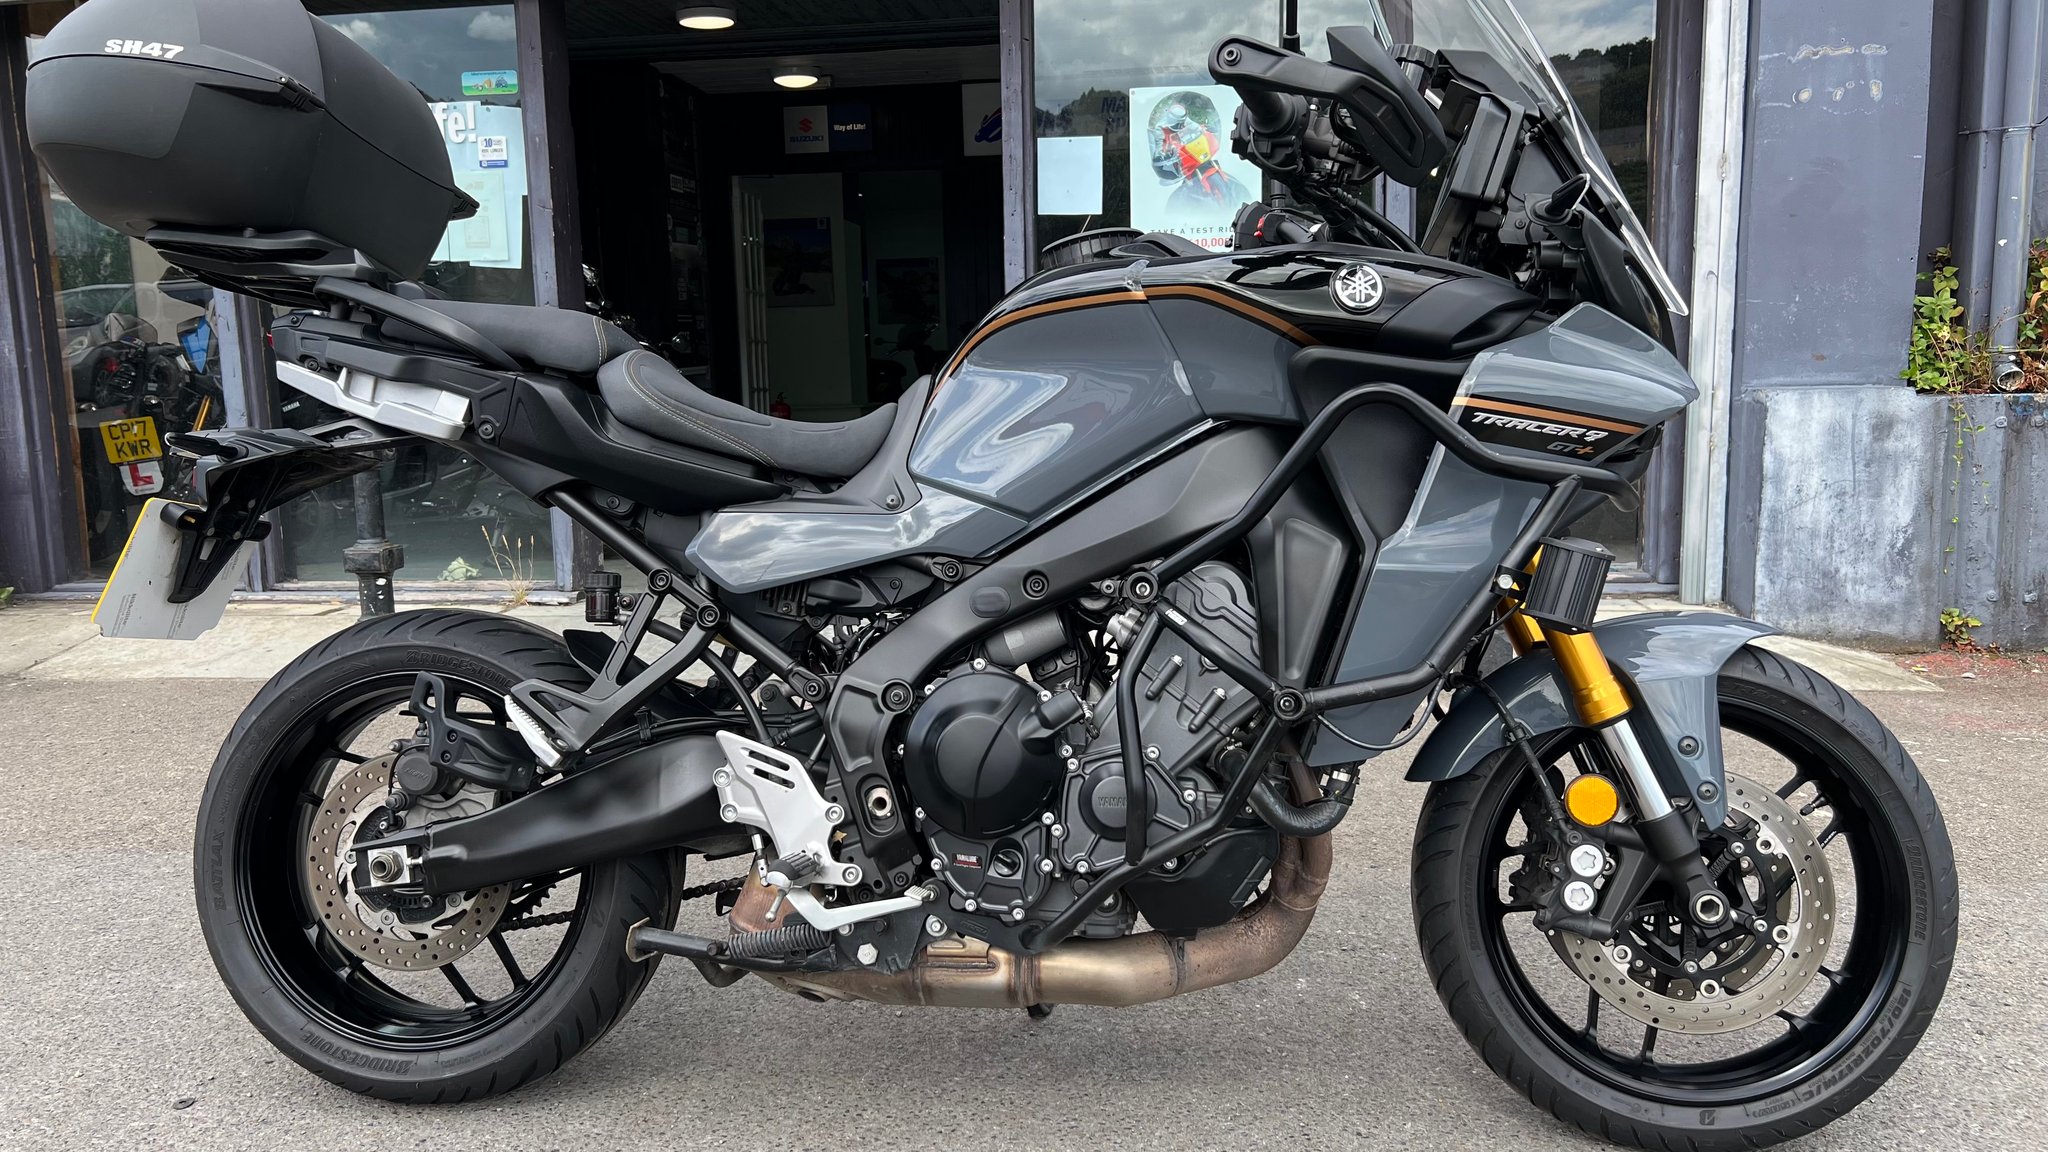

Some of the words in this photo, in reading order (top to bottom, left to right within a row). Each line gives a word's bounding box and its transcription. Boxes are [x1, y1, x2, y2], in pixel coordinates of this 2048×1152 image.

[104, 39, 184, 59] SH47
[433, 102, 477, 144] fe!
[114, 439, 152, 459] KWR
[129, 463, 155, 487] L
[406, 648, 516, 690] BRIDGESTONE
[1097, 796, 1127, 807] YAMA
[1908, 844, 1928, 941] BRIDGESTONE
[301, 1031, 413, 1077] BRIDGESTONE
